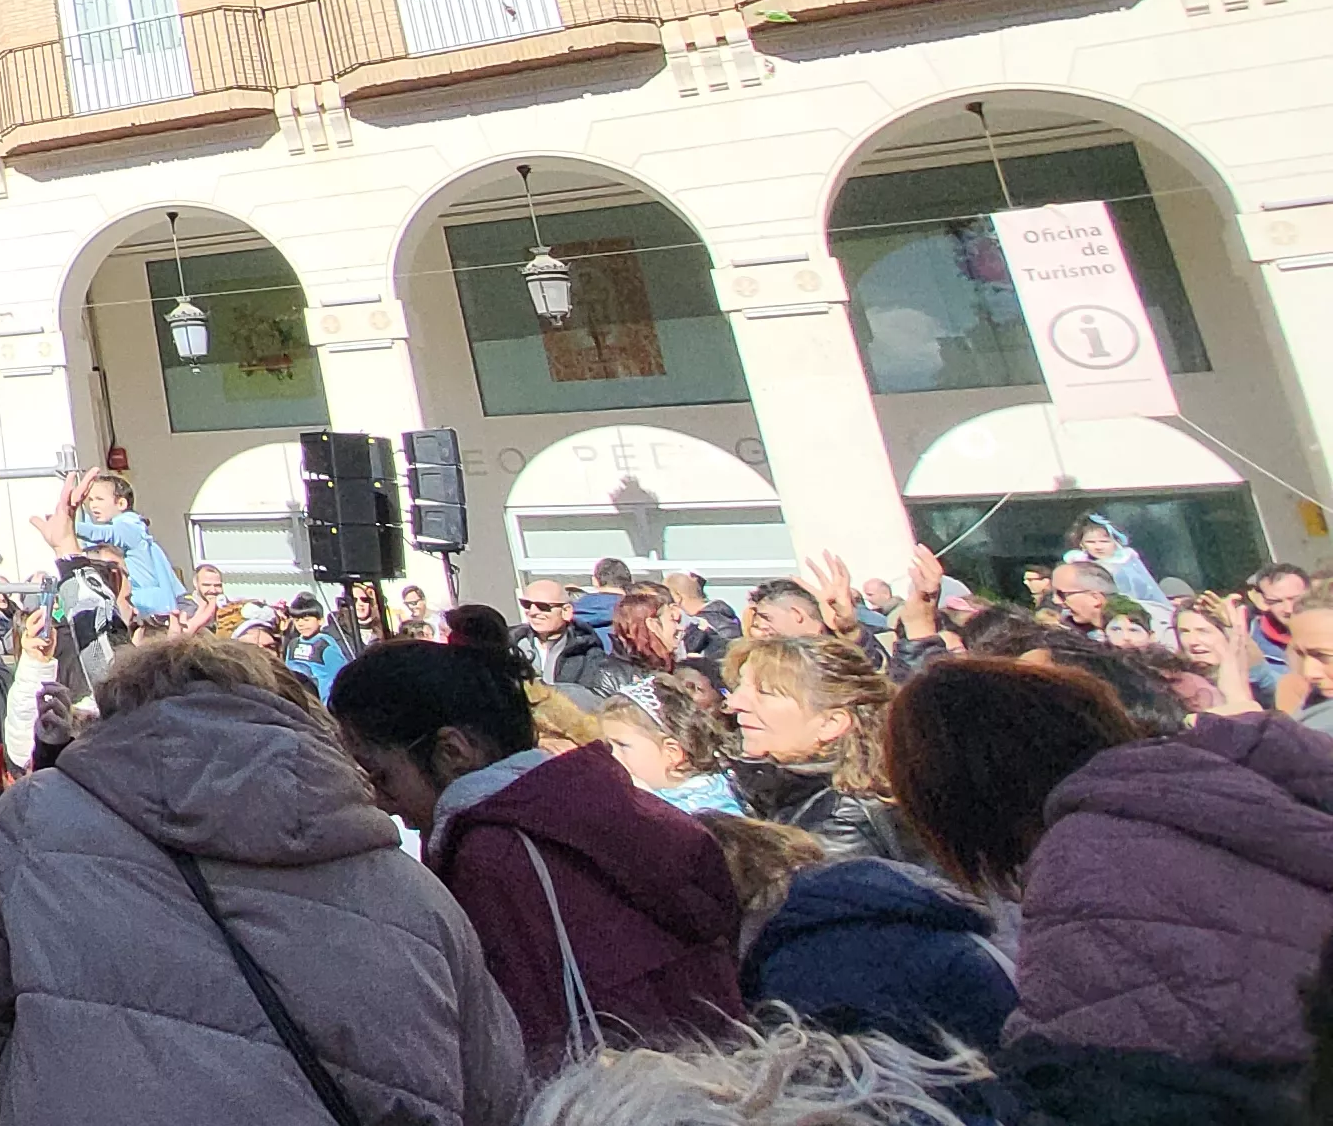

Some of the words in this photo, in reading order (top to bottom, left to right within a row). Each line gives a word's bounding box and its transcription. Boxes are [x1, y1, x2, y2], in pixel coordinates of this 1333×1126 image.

[1023, 225, 1102, 244] Oficina
[1081, 241, 1109, 256] de
[1021, 263, 1116, 281] Turismo
